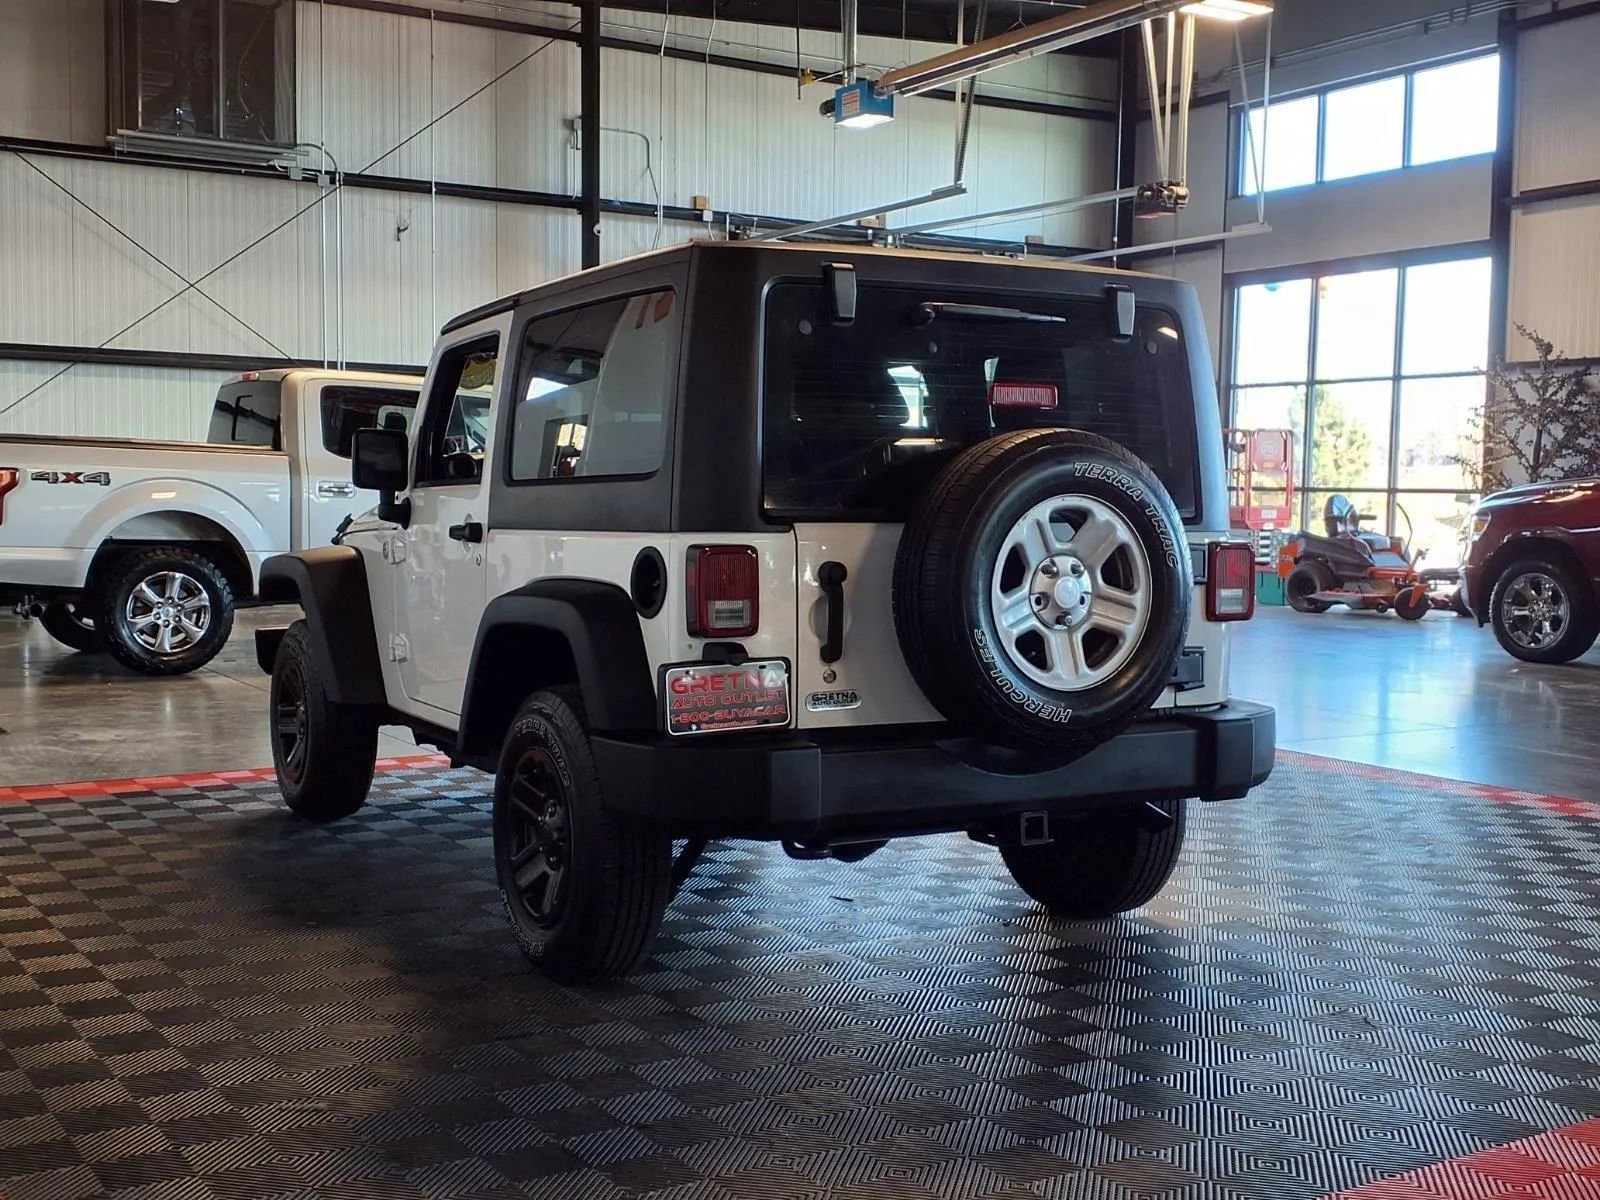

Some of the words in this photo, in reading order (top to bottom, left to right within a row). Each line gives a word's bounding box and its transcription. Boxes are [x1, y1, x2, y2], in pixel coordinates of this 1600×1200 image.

[1073, 462, 1145, 502] TERRA
[1145, 502, 1179, 568] TRAC
[671, 670, 783, 695] GRETNA
[974, 628, 1073, 723] HERCULES
[671, 695, 716, 709] AUTO
[720, 688, 785, 705] OUTLET
[812, 691, 858, 702] GRETNA
